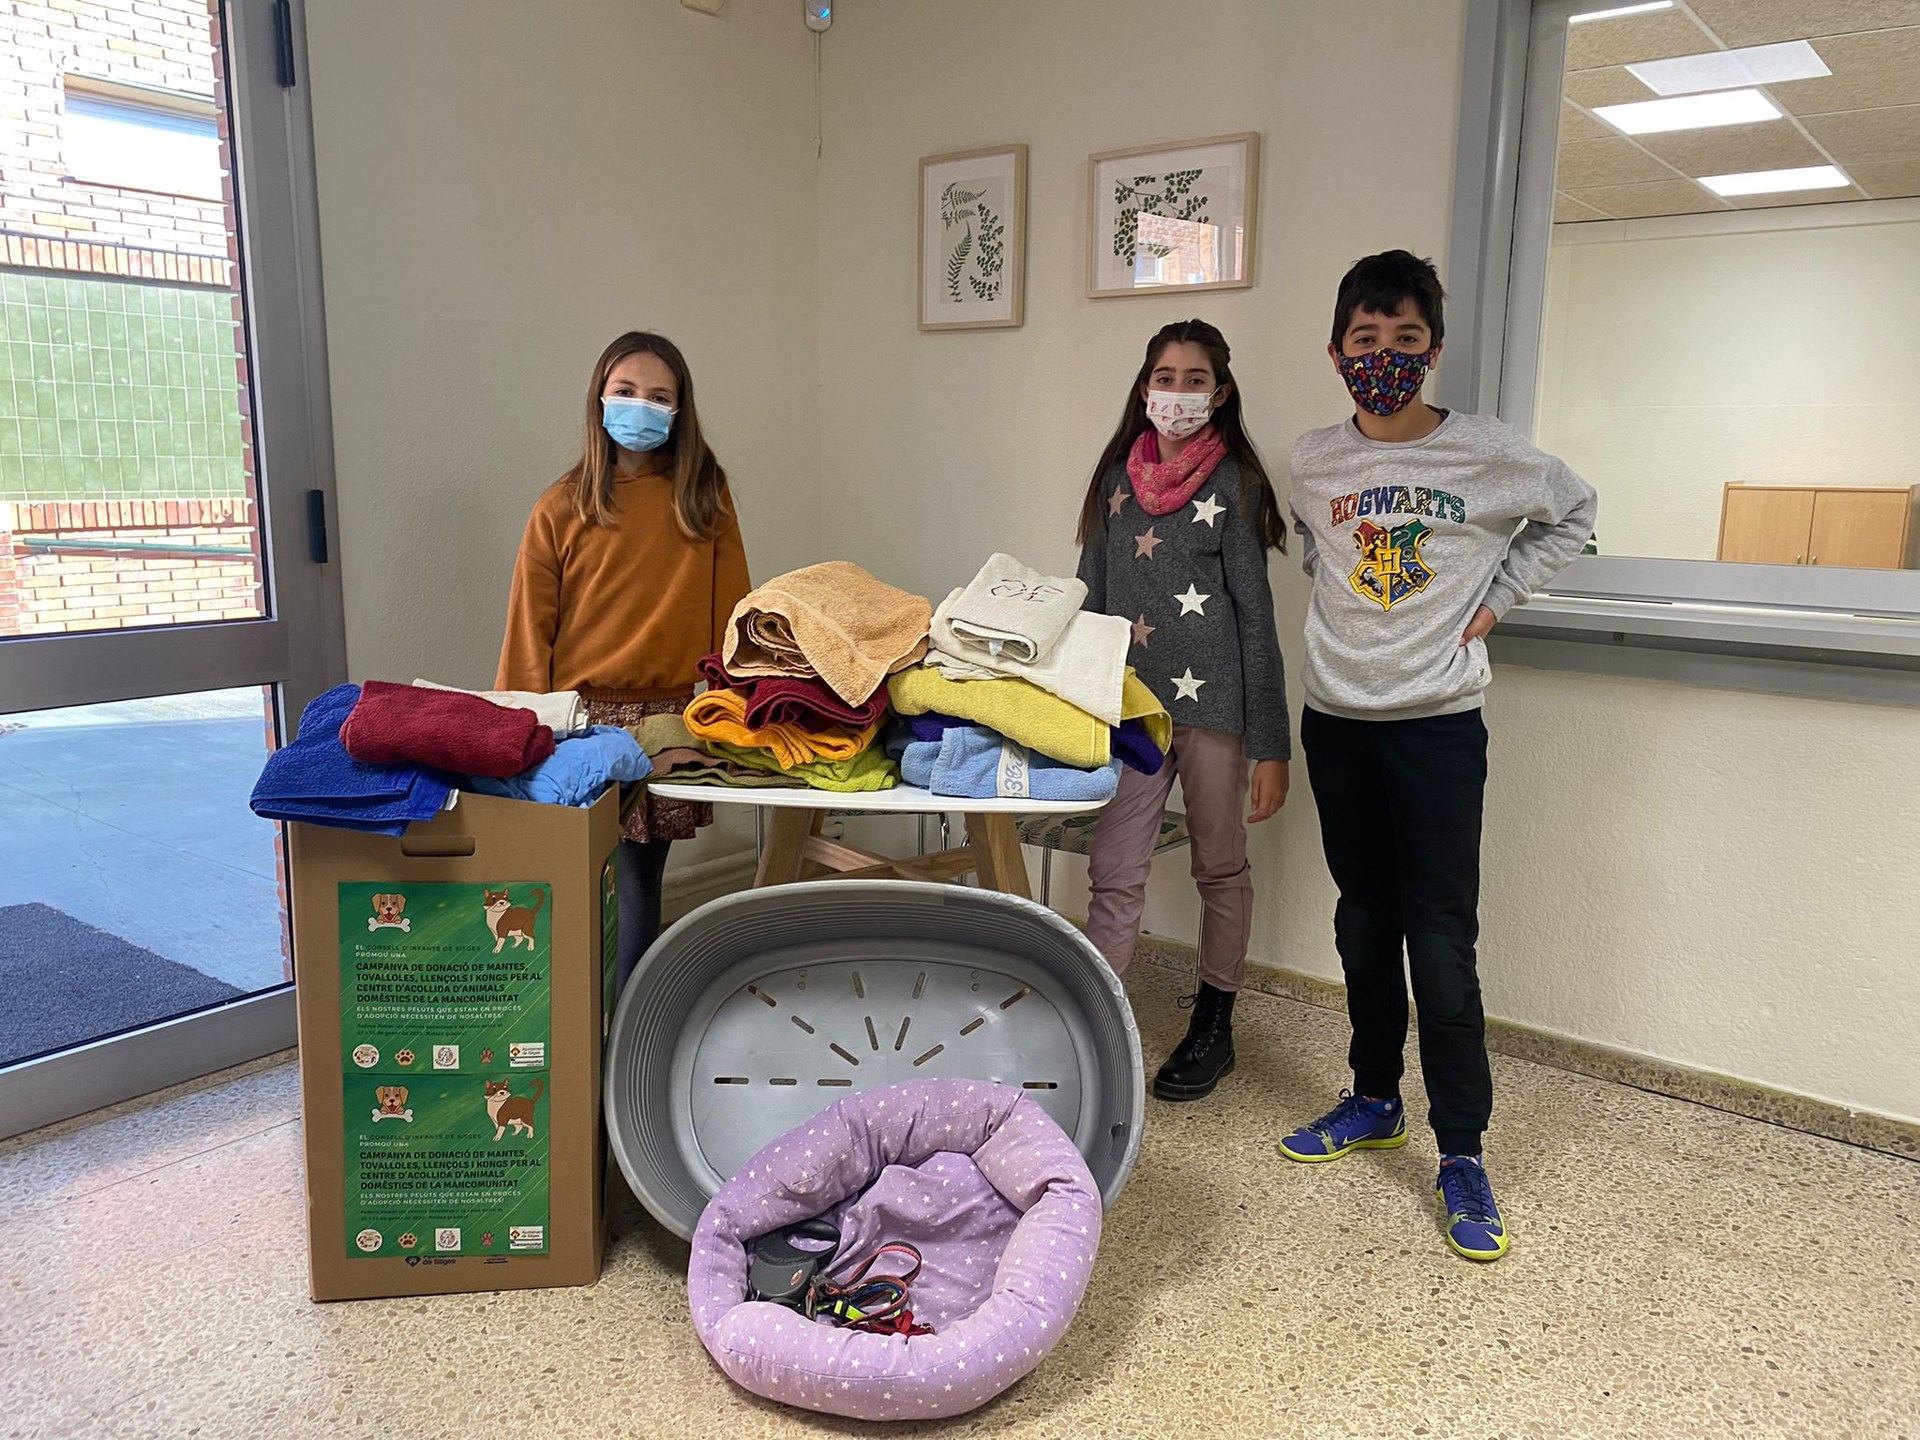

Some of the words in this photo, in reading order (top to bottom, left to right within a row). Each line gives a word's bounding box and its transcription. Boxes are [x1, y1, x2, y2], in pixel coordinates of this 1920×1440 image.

[1330, 486, 1465, 527] HOGWARTS
[1379, 552, 1397, 572] H
[356, 963, 408, 971] CAMPANYA
[426, 962, 469, 971] DONACIÓ
[486, 963, 528, 971] MANTES,
[357, 974, 418, 982] TOVALLOLES,
[421, 974, 467, 984] LLENÇOLS
[475, 973, 508, 981] KONGS
[357, 984, 393, 992] CENTRE
[396, 984, 450, 993] D'ACOLLIDA
[453, 984, 505, 992] D'ANIMALS
[357, 993, 410, 1002] DOMÈSTICS
[441, 994, 519, 1003] MANCOMUNITAT
[429, 1150, 470, 1158] DONACIÓ
[487, 1150, 527, 1158] MANTES,
[360, 1162, 421, 1170] TOVALLOLES,
[423, 1161, 469, 1170] LLENÇOLS
[477, 1160, 508, 1168] KONGS
[455, 1170, 505, 1178] D'ANIMALS
[361, 1181, 413, 1189] DOMÈSTICS
[443, 1180, 518, 1188] MANCOMUNITAT
